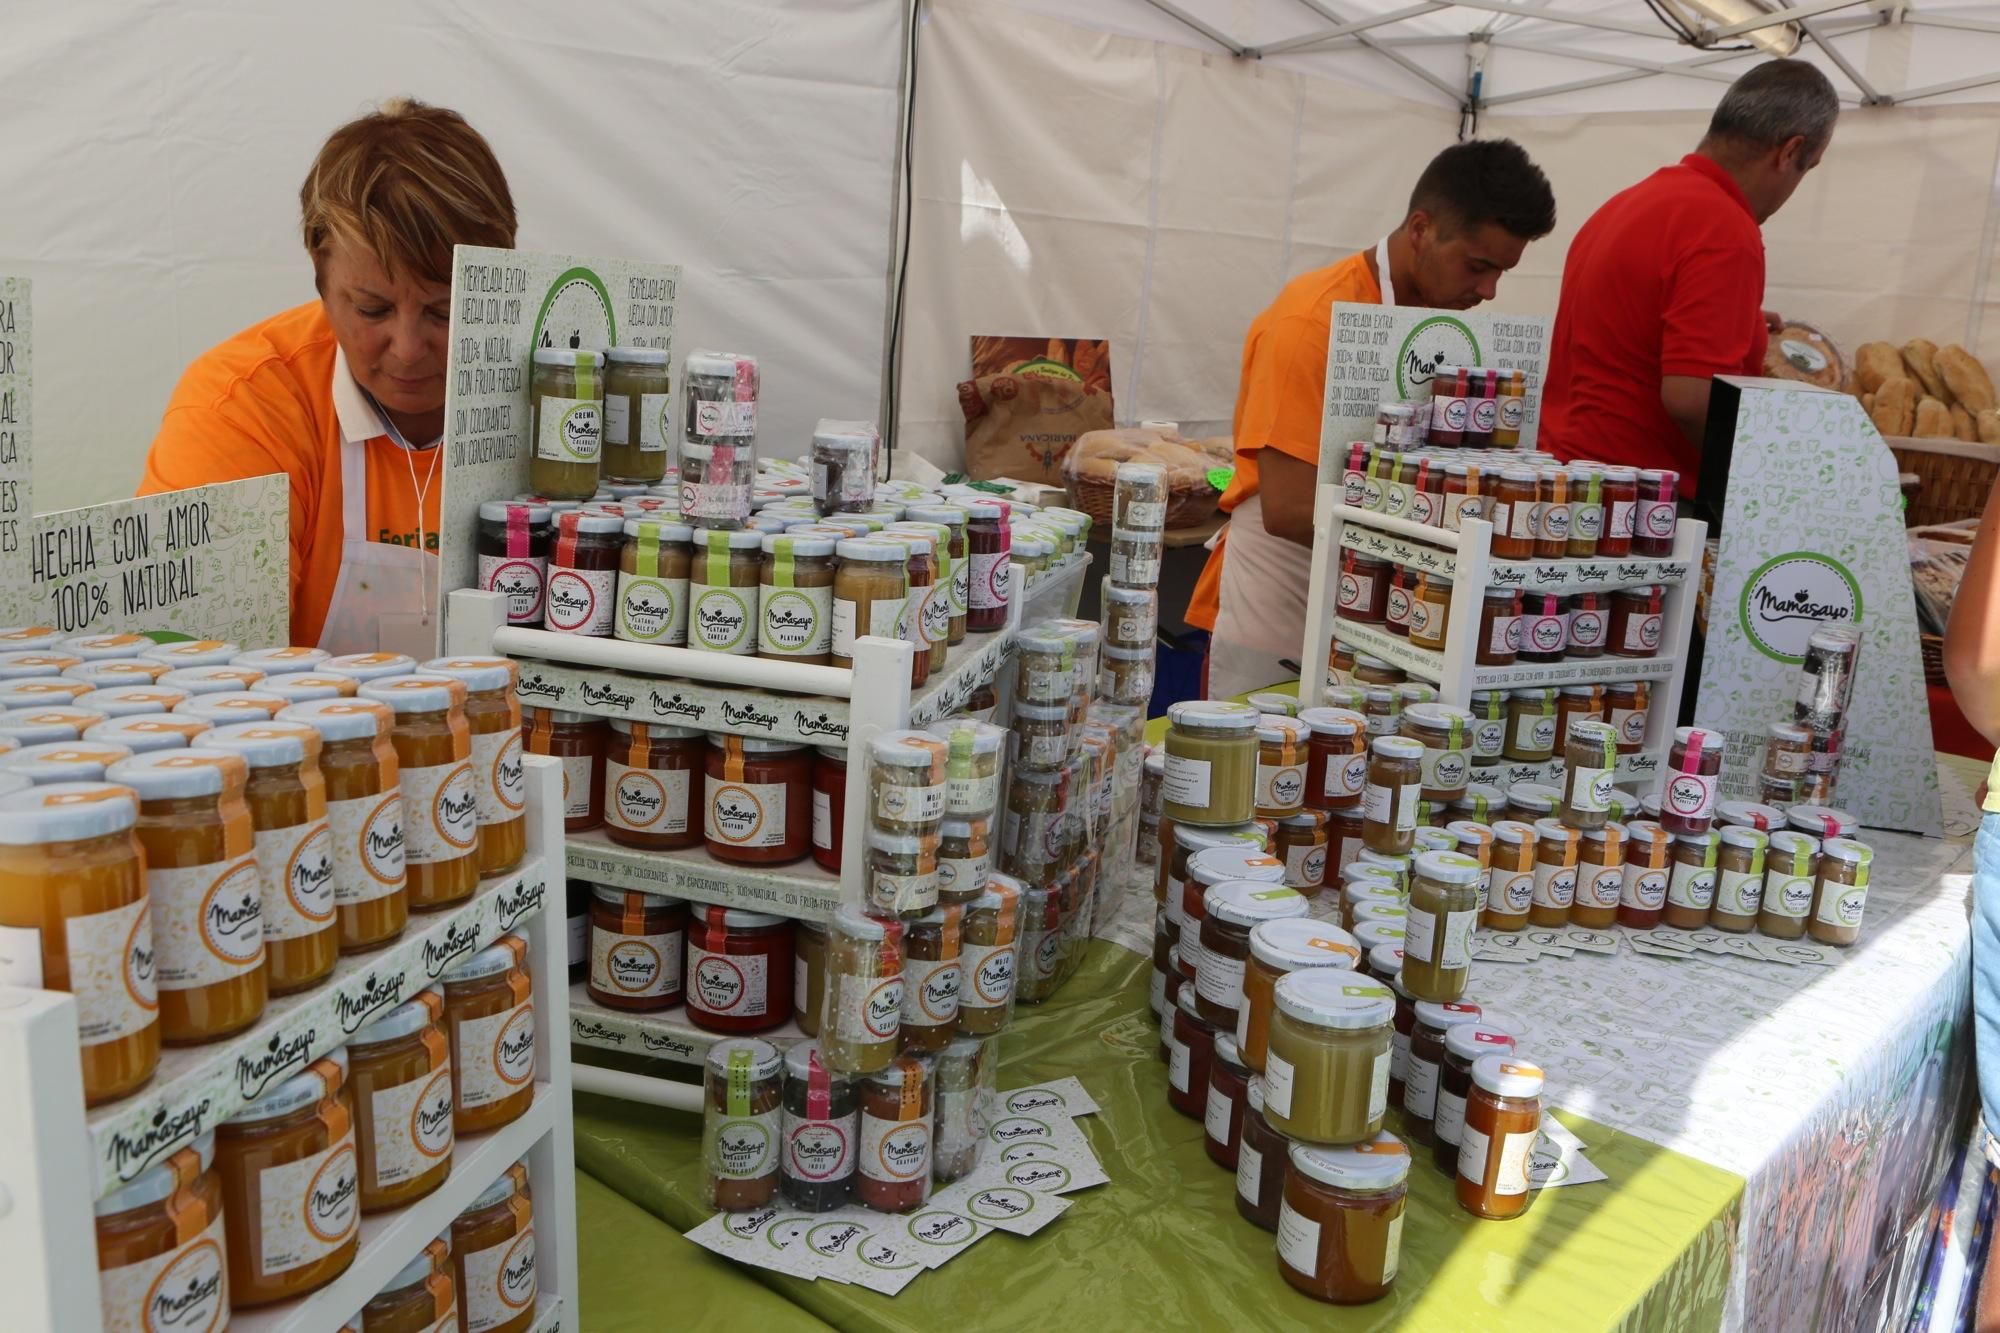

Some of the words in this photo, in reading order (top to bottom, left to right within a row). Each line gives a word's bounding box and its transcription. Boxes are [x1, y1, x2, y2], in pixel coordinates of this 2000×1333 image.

[464, 264, 502, 292] MERMELADA
[505, 267, 526, 293] EXTRA
[462, 298, 484, 324] HECHA
[486, 298, 500, 324] CON
[502, 299, 521, 325] AMOR
[1339, 312, 1372, 328] MERMELADA
[1374, 314, 1393, 328] EXTRA
[1337, 329, 1356, 344] HECHA
[1358, 330, 1370, 344] CON
[1372, 331, 1389, 345] AMOR
[460, 337, 480, 364] 100%
[484, 336, 512, 363] NATURAL
[1336, 350, 1353, 363] 100%
[1357, 350, 1381, 365] NATURAL
[458, 369, 473, 396] CON
[475, 368, 496, 394] FRUTA
[498, 367, 521, 393] FRESCA
[1334, 366, 1346, 380] CON
[1348, 366, 1366, 381] FRUTA
[1368, 367, 1390, 381] FRESCA
[1332, 386, 1341, 400] SIN
[1344, 386, 1380, 401] COLORANTES
[455, 407, 467, 436] SIN
[470, 404, 512, 434] COLORANTES
[575, 411, 594, 419] CREMA
[1330, 403, 1340, 417] SIN
[453, 442, 466, 468] SIN
[468, 434, 518, 465] CONSERVANTES
[32, 525, 97, 584] HECHA
[113, 512, 149, 564] CON
[165, 501, 211, 552] AMOR
[1492, 568, 1526, 585] Mamasayo
[1535, 567, 1568, 583] Mamasayo
[1576, 565, 1608, 581] Mamasayo
[1617, 564, 1648, 580] Mamasayo
[1656, 563, 1687, 579] Mamasayo
[52, 580, 108, 632] 100%
[123, 556, 199, 616] NATURAL
[495, 579, 539, 598] Mamasayo
[551, 587, 588, 612] Mamasayo
[625, 596, 668, 619] Mamasayo
[1755, 586, 1848, 619] Mamasayo
[698, 607, 742, 629] Mamasayo
[768, 609, 812, 630] Mamasayo
[580, 681, 635, 710] Mamasayo
[650, 691, 705, 720] Mamasayo
[721, 701, 778, 730] Mamasayo
[619, 787, 660, 809] Mamasayo
[716, 801, 756, 824] Mamasayo
[611, 955, 655, 975] Mamasayo
[698, 970, 739, 994] Mamasayo
[107, 1099, 210, 1175] Mamasayo
[236, 1028, 315, 1094] Mamasayo
[336, 972, 405, 1027] Mamasayo
[422, 924, 480, 971] Mamasayo
[495, 881, 545, 925] Mamasayo
[573, 1018, 626, 1044] Mamasayo
[640, 1031, 694, 1057] Mamasayo
[1012, 1098, 1058, 1111] Mamasayo
[996, 1127, 1044, 1139] Mamasayo
[795, 1140, 840, 1158] Mamasayo
[1013, 1169, 1061, 1184] Mamasayo
